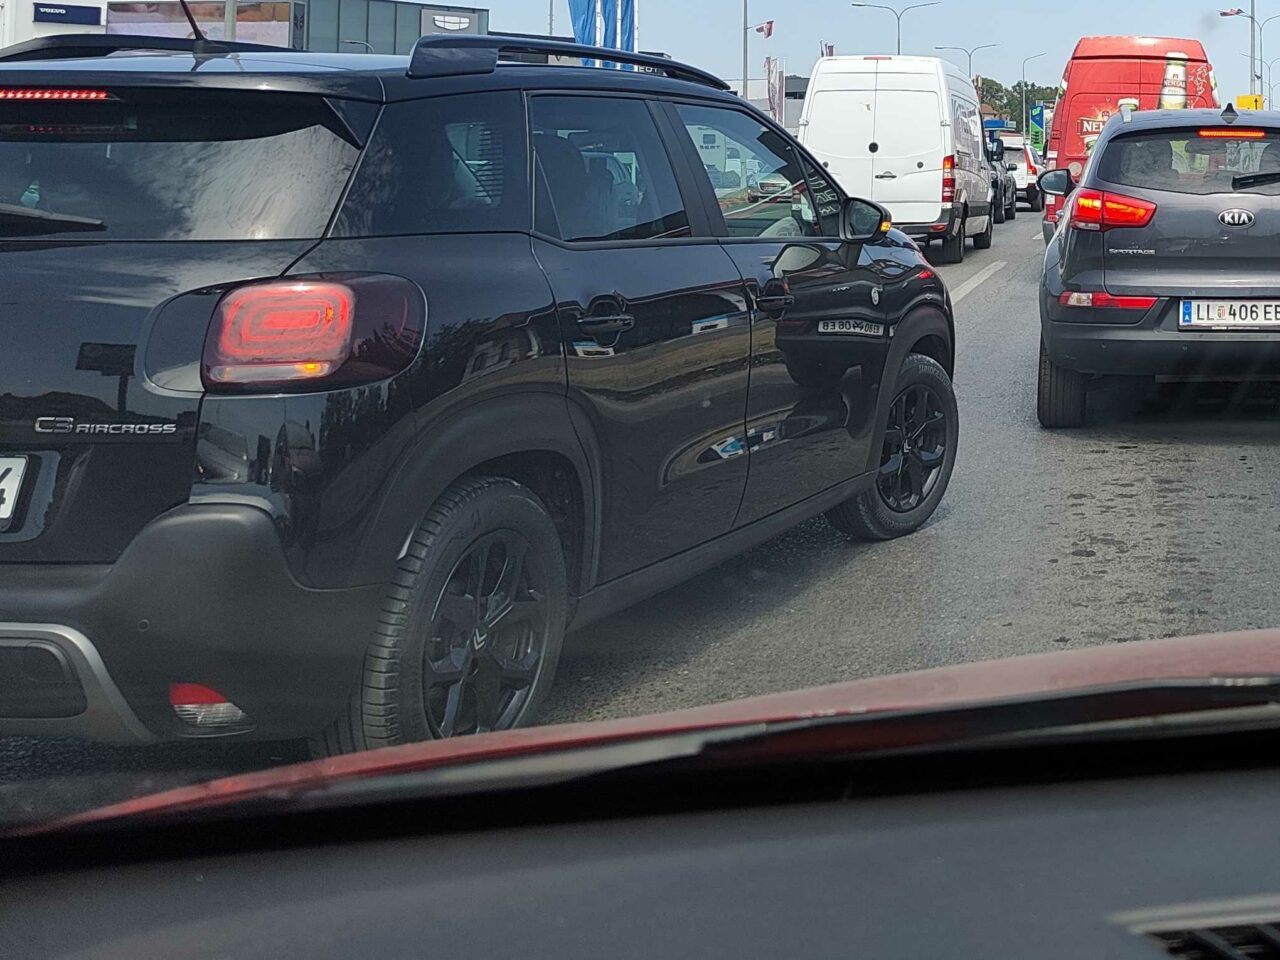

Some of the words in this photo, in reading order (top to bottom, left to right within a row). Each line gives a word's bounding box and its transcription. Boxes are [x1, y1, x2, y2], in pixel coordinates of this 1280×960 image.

[1224, 212, 1248, 224] KIA
[1196, 306, 1215, 321] LL
[1228, 305, 1259, 321] 406
[35, 416, 74, 434] C3
[76, 424, 177, 434] AIRCROSS
